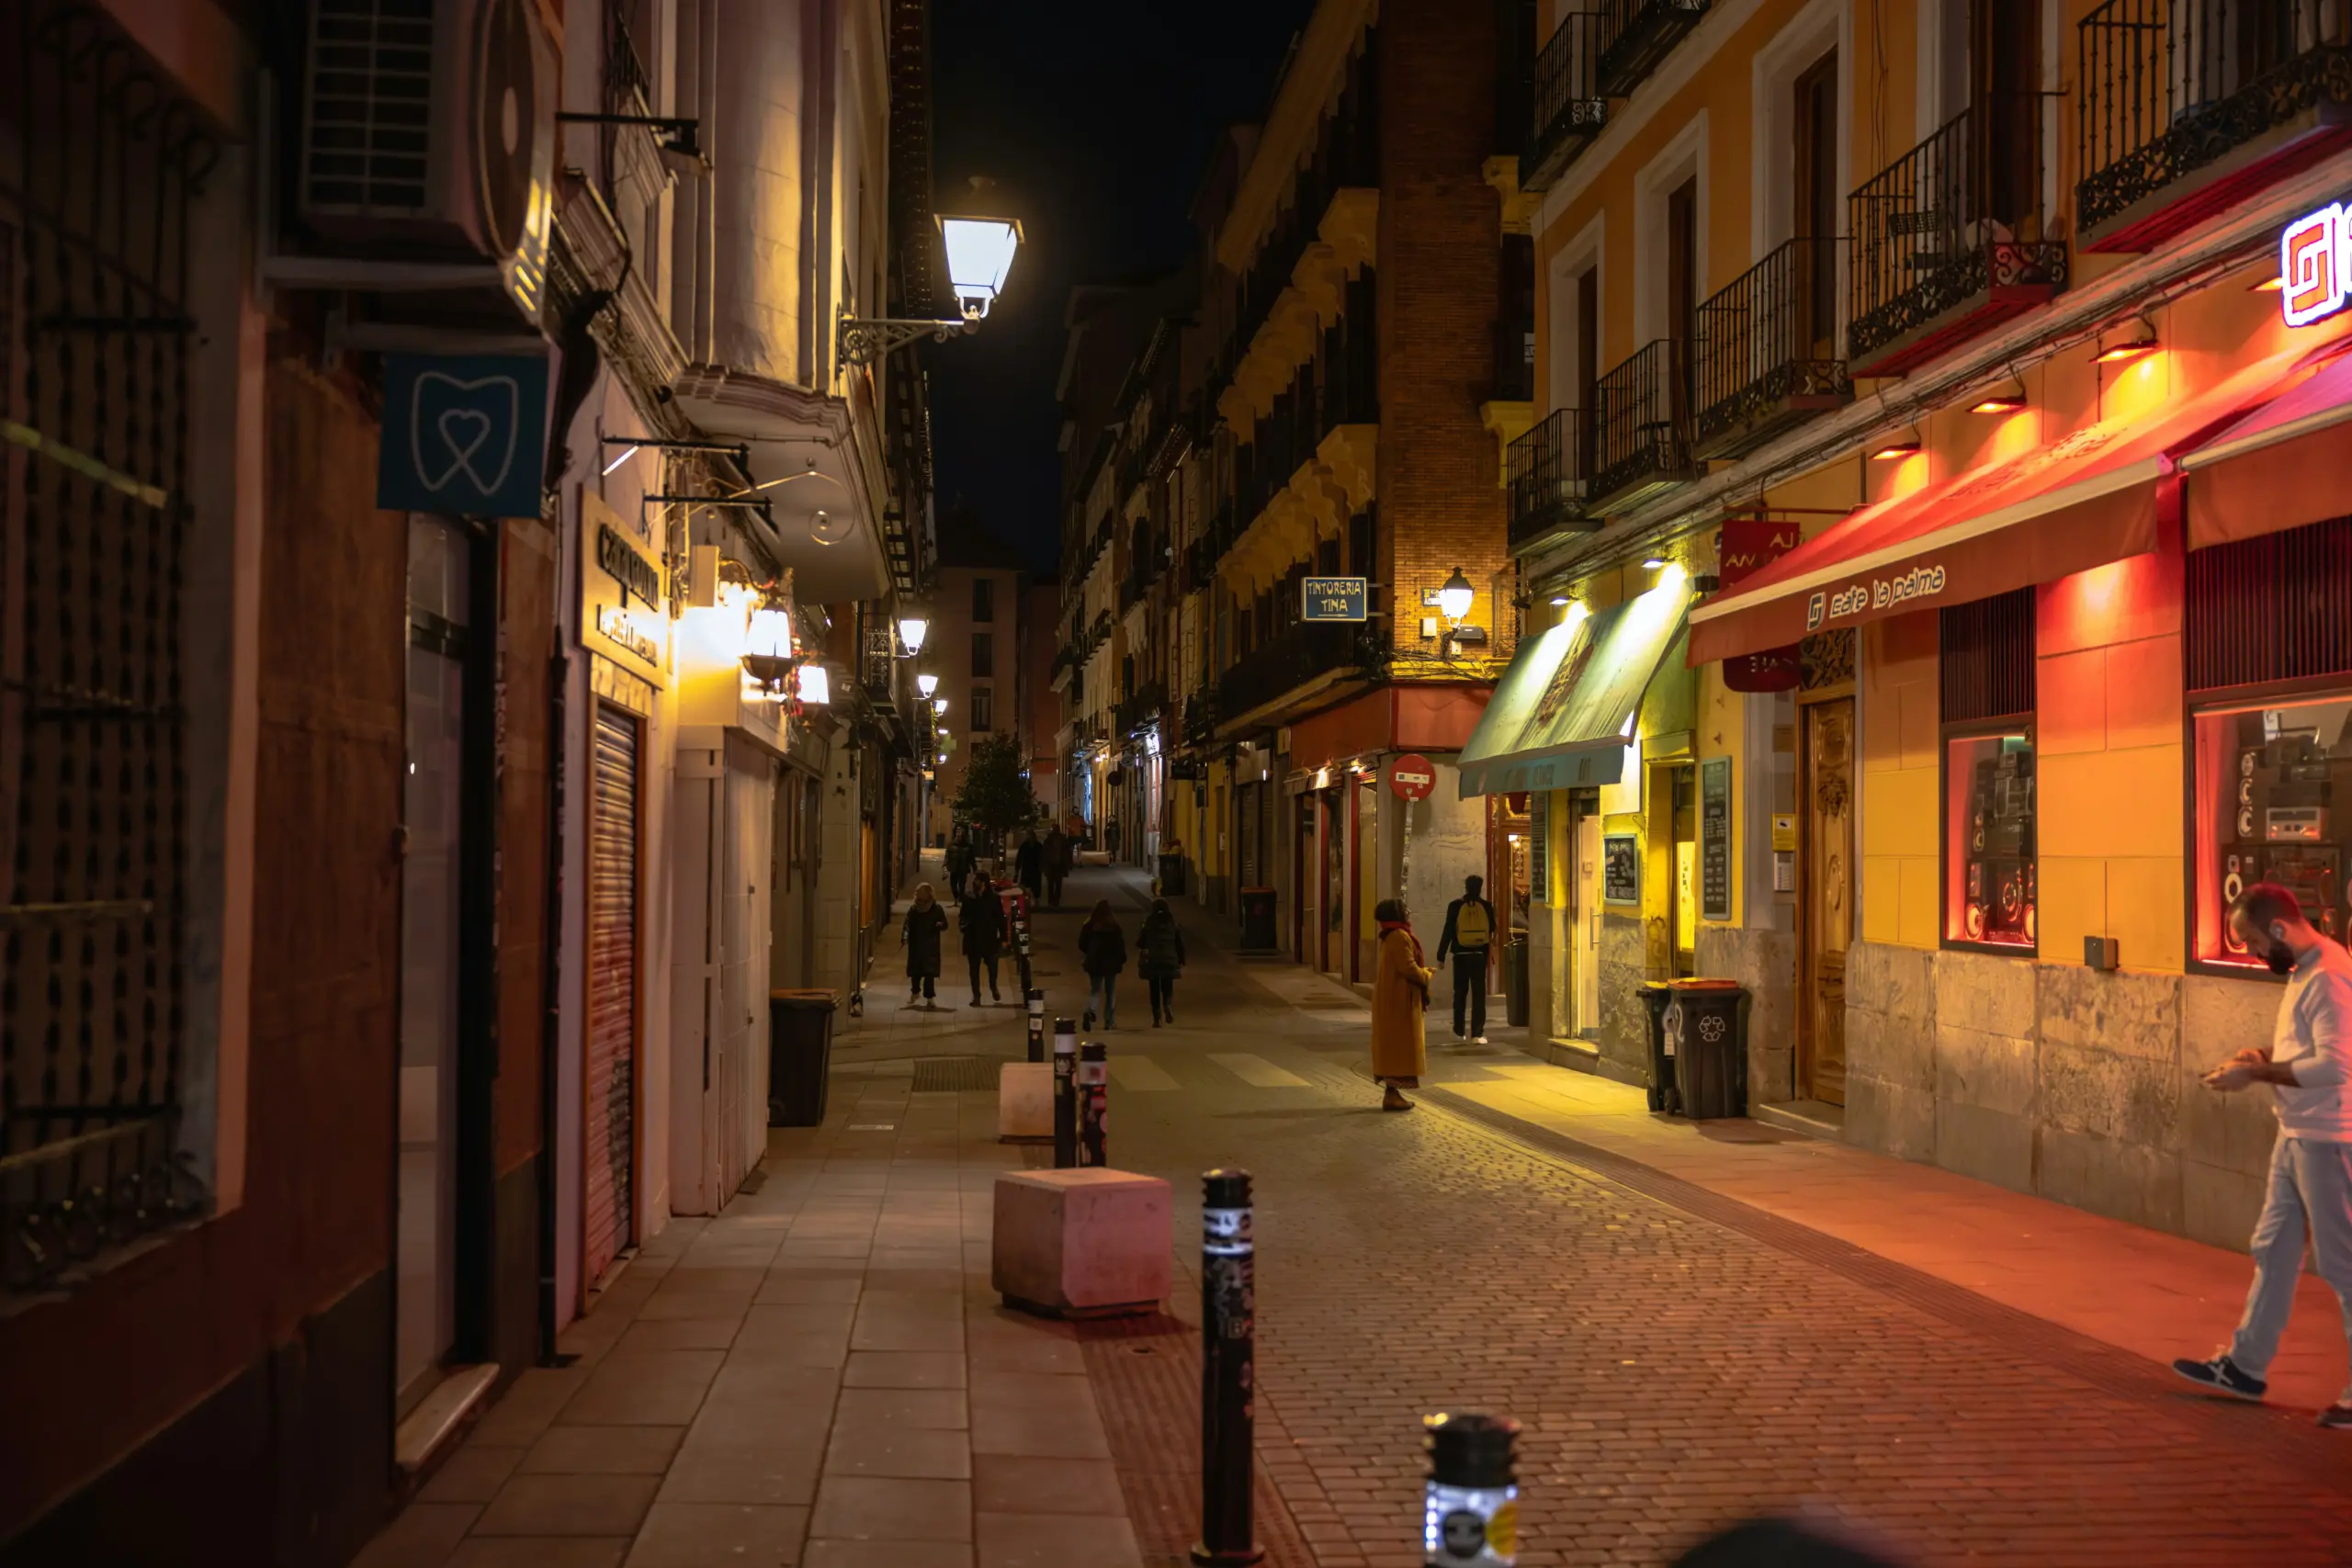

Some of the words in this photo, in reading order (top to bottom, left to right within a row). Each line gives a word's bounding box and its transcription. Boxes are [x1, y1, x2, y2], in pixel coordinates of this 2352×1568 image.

[1307, 581, 1362, 595] TINTORERIA
[1872, 579, 1891, 610] la
[1888, 565, 1945, 609] palma
[1320, 599, 1348, 612] TINA
